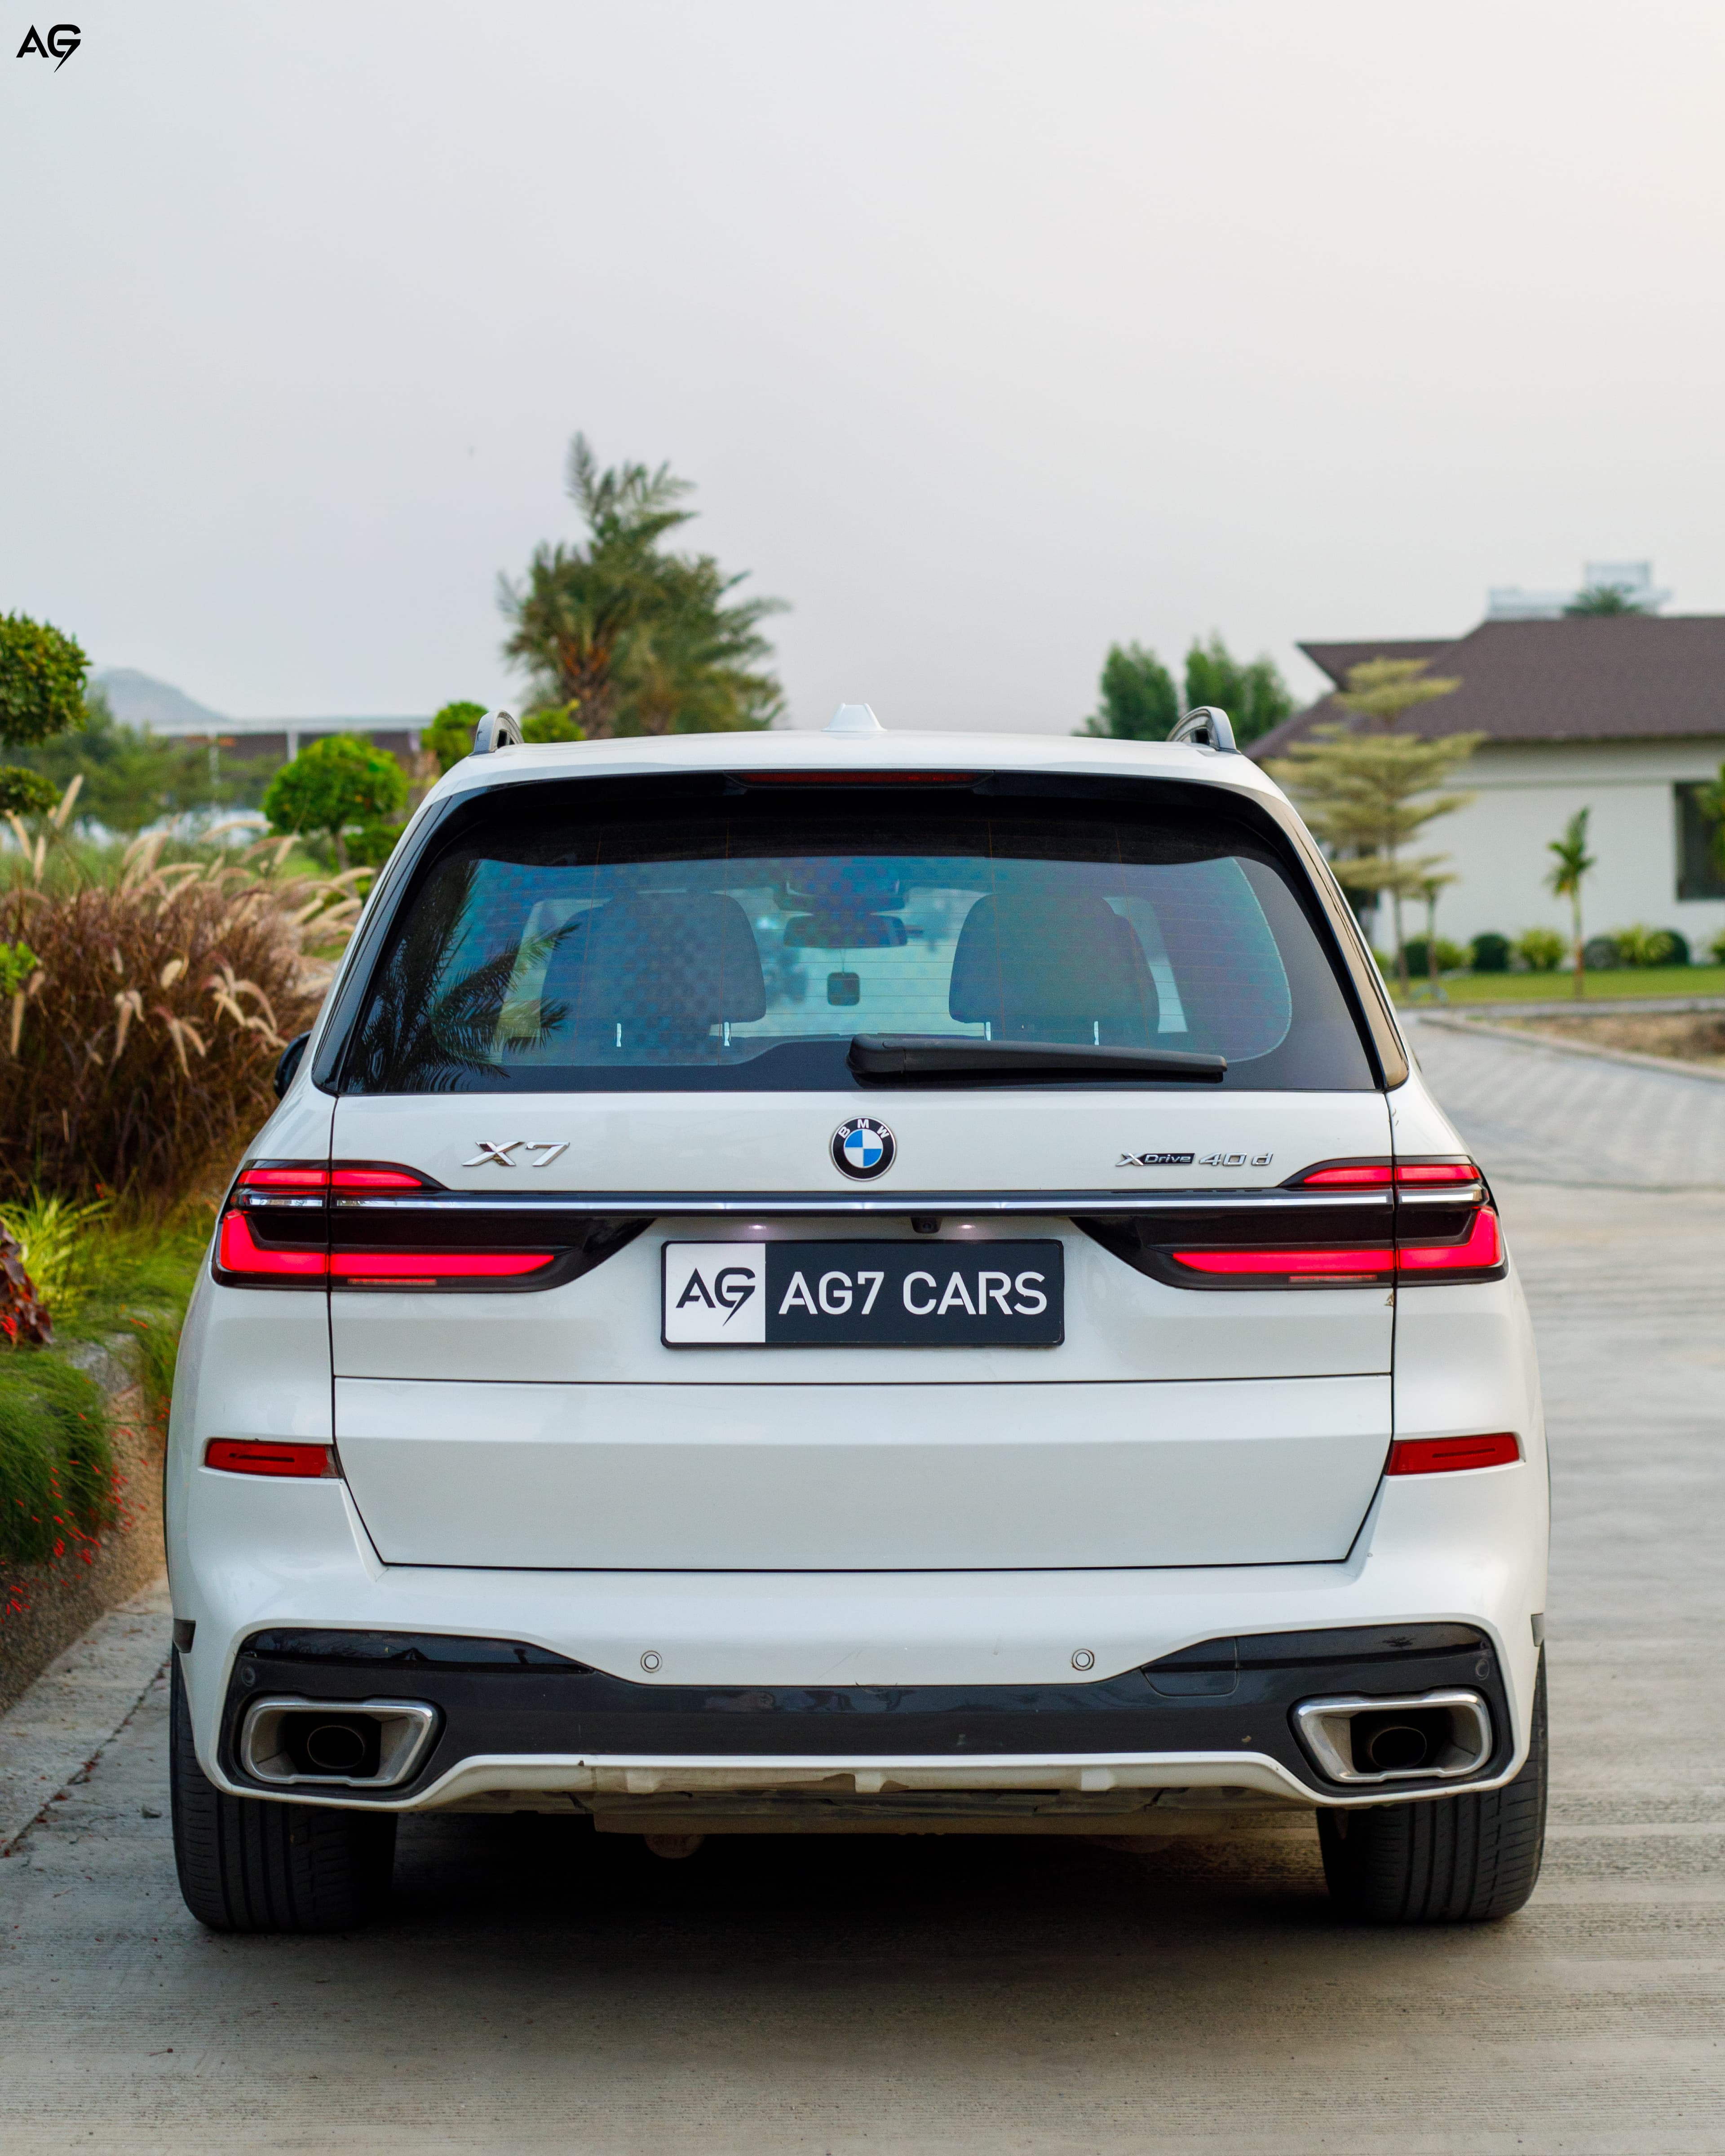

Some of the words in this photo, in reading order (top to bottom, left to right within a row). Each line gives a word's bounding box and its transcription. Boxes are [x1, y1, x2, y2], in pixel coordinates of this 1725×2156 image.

[838, 1118, 889, 1139] BMW
[461, 1141, 570, 1166] X7
[778, 1271, 885, 1315] AG7
[902, 1271, 1048, 1315] CARS
